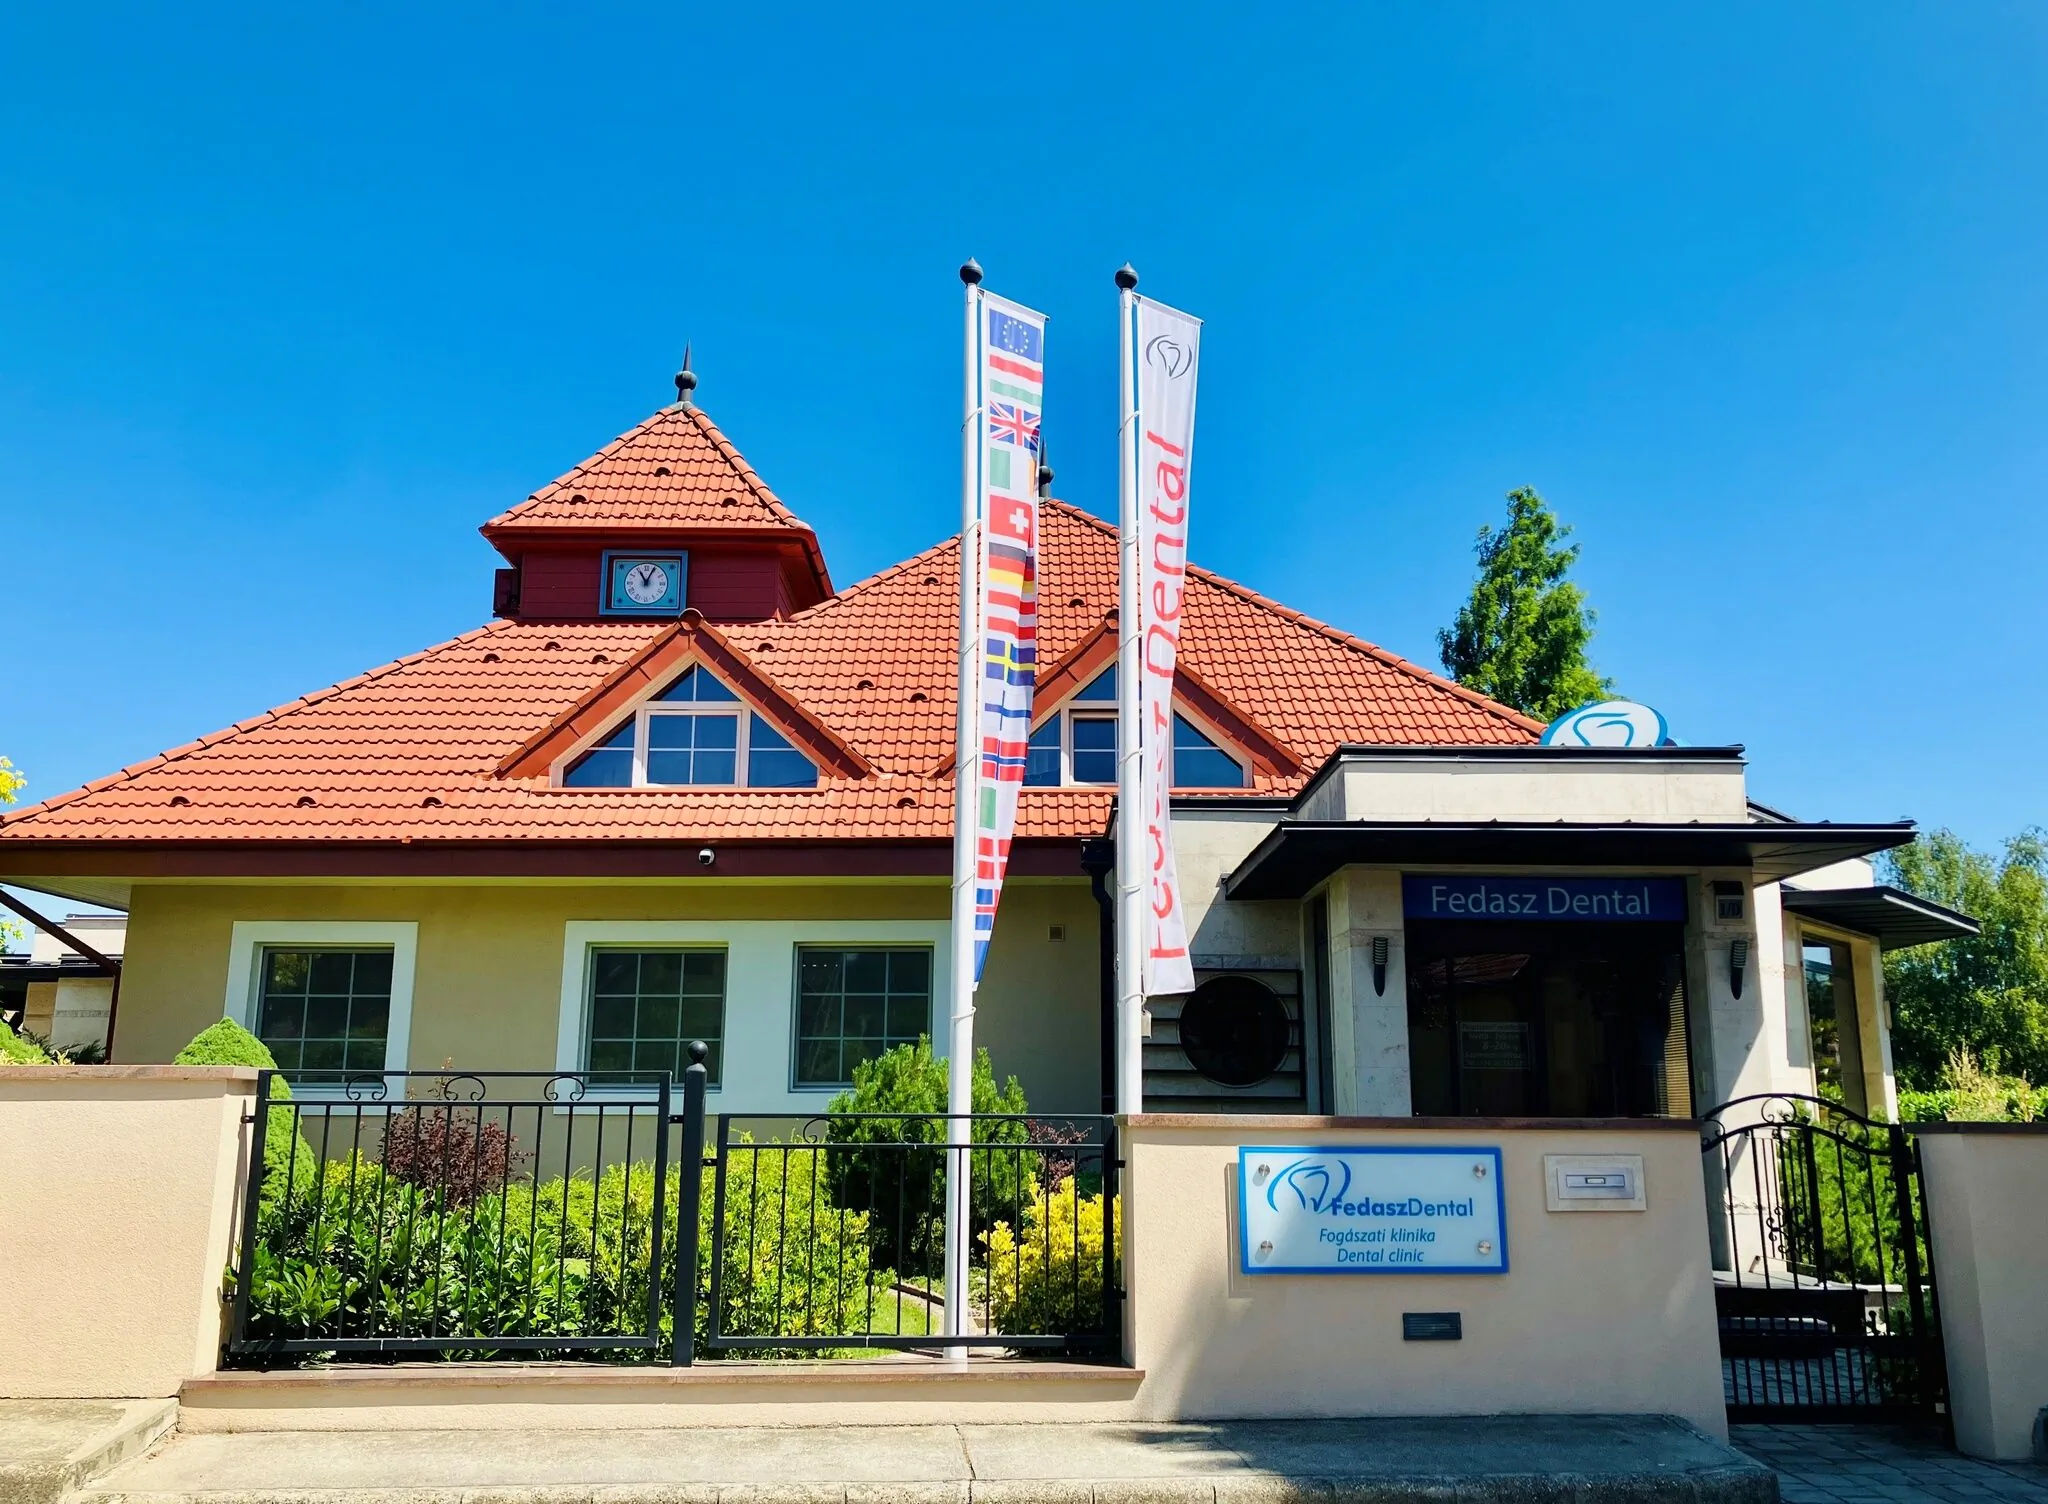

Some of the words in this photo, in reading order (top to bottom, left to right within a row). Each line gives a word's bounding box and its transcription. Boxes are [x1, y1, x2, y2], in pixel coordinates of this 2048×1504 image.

[1146, 429, 1185, 679] Dental
[1431, 885, 1538, 914] Fedasz
[1547, 886, 1650, 915] Dental
[1332, 1197, 1474, 1217] FedaszDental
[1319, 1228, 1386, 1246] Fogászati
[1390, 1228, 1436, 1243] klinika
[1337, 1248, 1384, 1263] Dental
[1388, 1248, 1425, 1263] clinic
